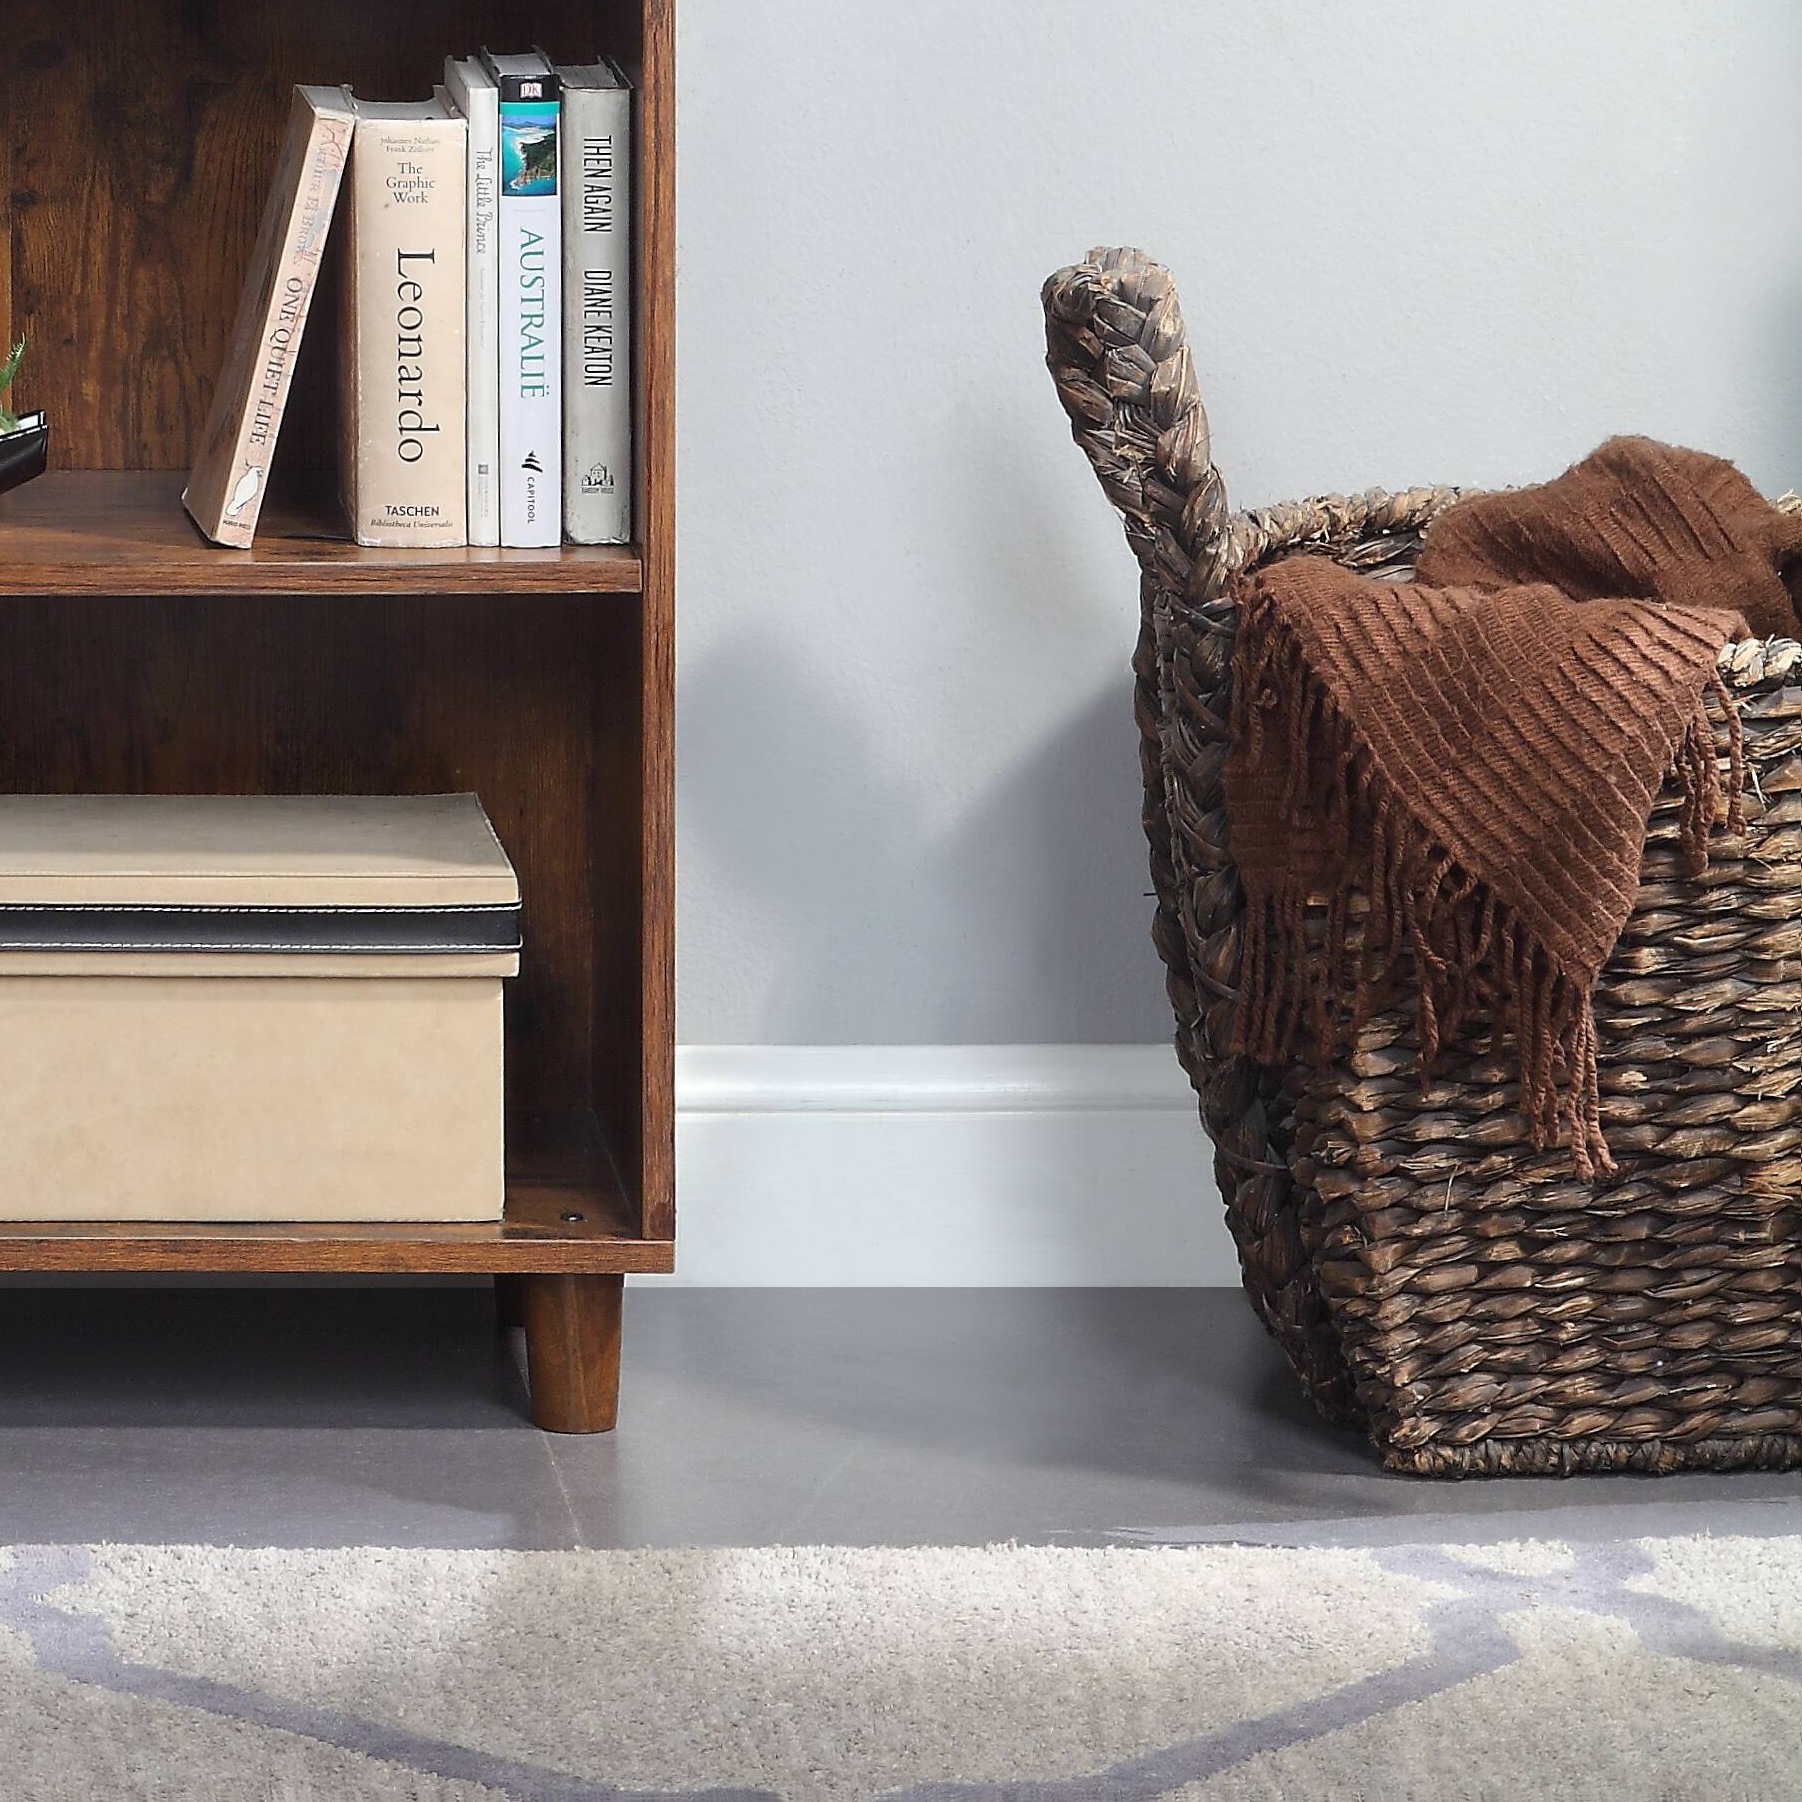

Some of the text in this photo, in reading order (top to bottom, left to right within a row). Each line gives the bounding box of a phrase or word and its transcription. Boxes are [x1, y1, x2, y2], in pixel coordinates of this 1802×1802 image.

[521, 83, 542, 97] DK
[397, 161, 423, 174] The
[476, 147, 493, 171] The
[385, 176, 436, 192] Graphic
[393, 191, 429, 204] Work
[476, 172, 493, 209] Little
[583, 134, 612, 233] THEN AGAIN
[476, 210, 494, 255] Prince
[520, 229, 550, 398] AUSTRALIË
[583, 269, 613, 386] DIANE KEATON
[249, 277, 303, 446] ONE QUIET LIFE
[397, 247, 441, 463] Leonardo
[384, 505, 440, 517] TASCHEN
[526, 476, 536, 524] CAPITOOL
